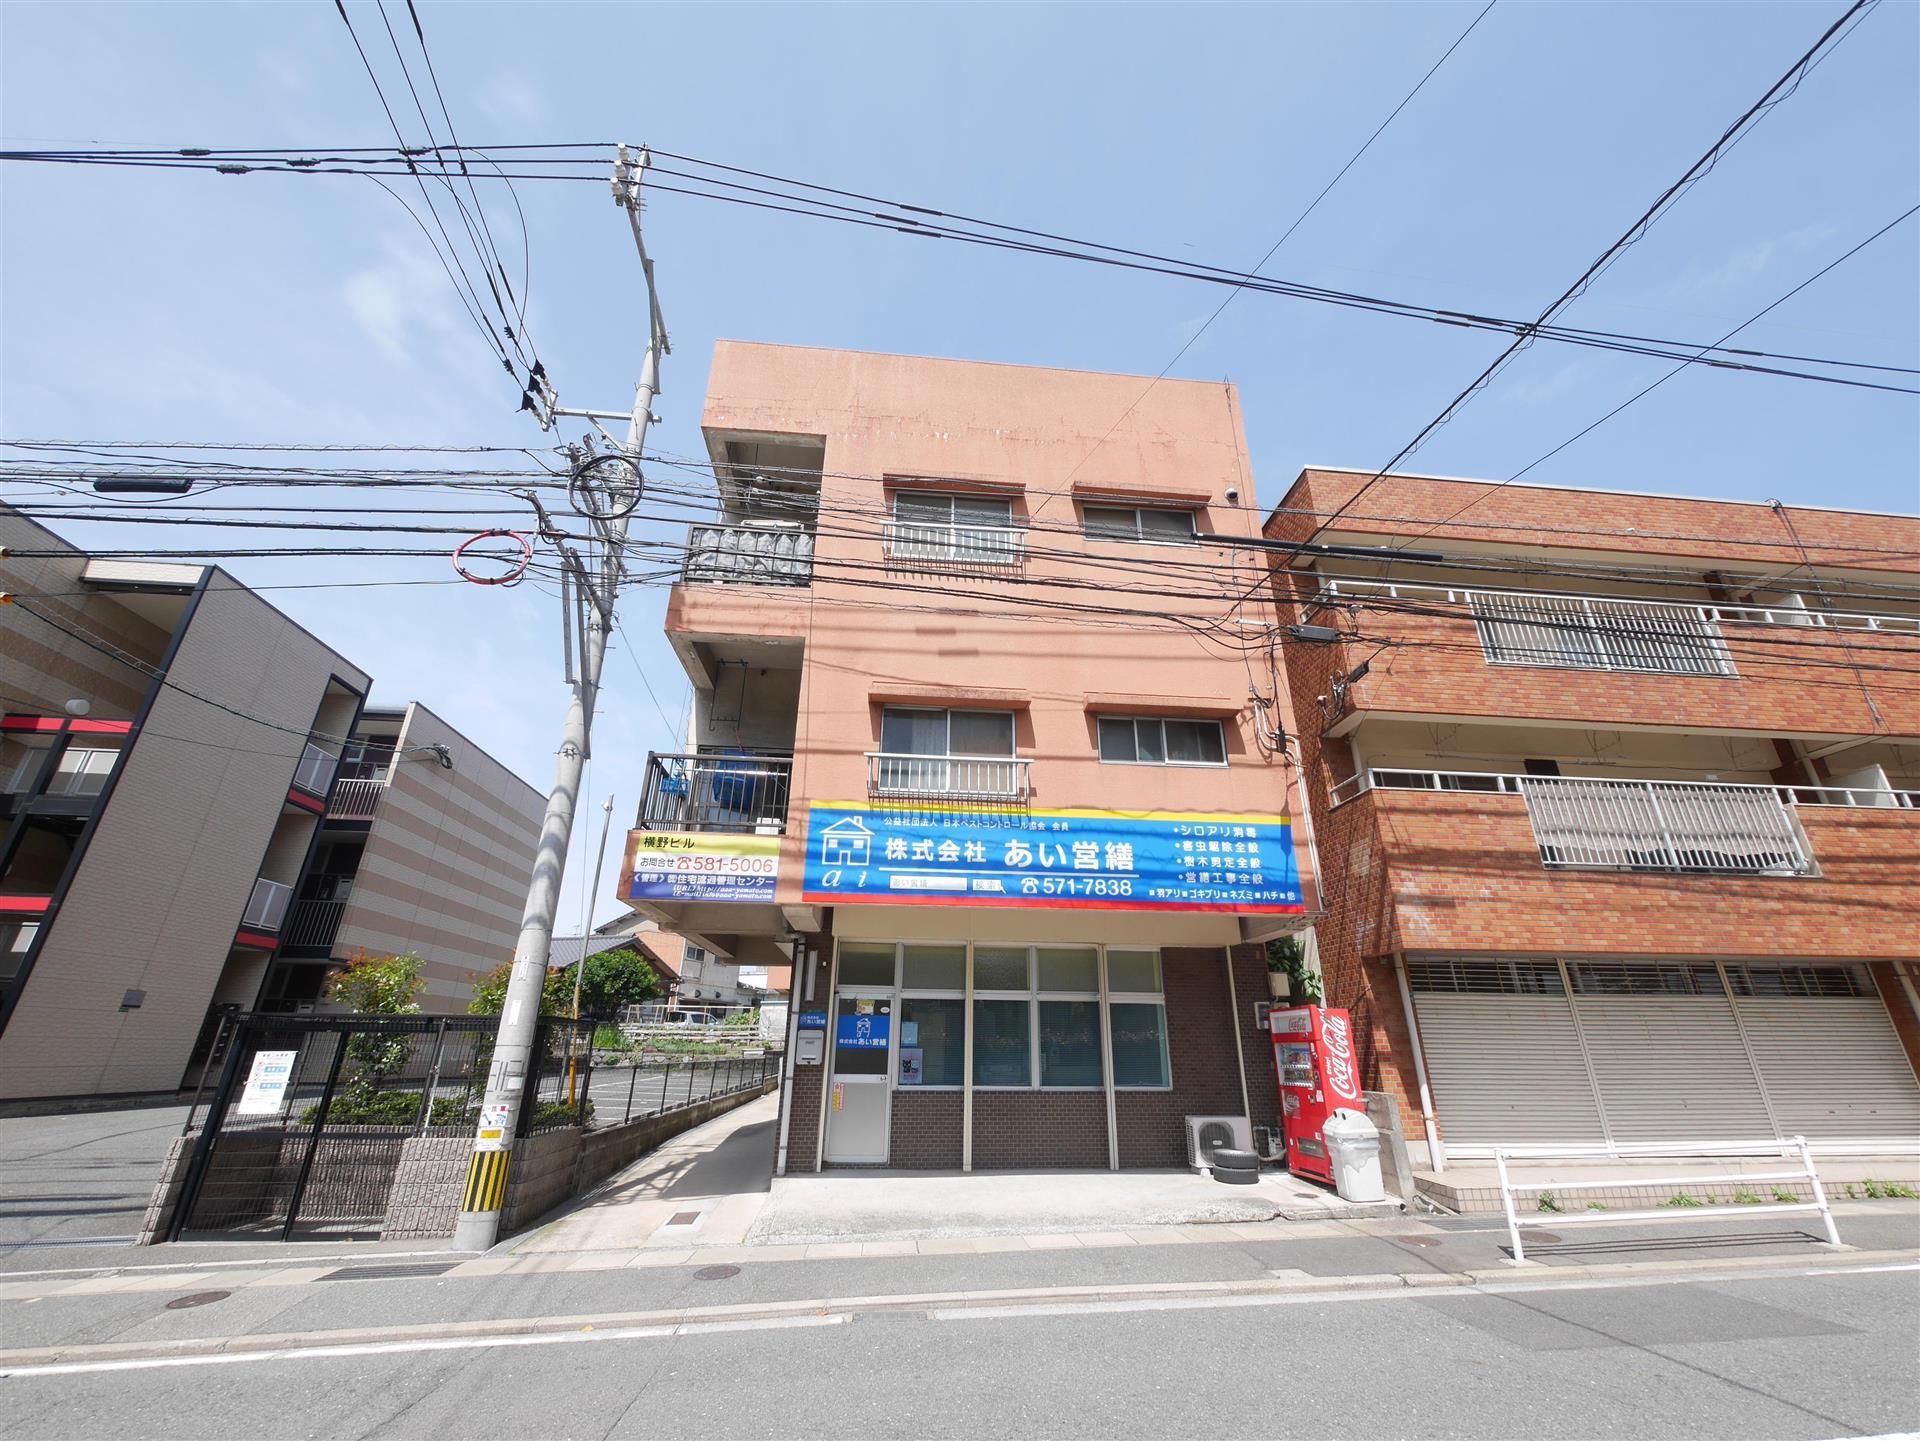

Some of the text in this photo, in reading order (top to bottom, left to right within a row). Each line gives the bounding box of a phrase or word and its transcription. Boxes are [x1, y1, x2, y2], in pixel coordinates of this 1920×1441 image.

[1052, 822, 1069, 831] 会員
[1181, 825, 1257, 838] シロアリ消毒
[644, 836, 695, 848] 横野ビル
[1182, 841, 1259, 853] 害虫駆除全般
[885, 838, 1134, 870] 株式会社 あい営繕
[640, 857, 773, 873] お問合せ 581-5006
[1184, 856, 1261, 869] 樹木剪定全般
[1185, 872, 1264, 885] 営繕工事全般
[1043, 878, 1132, 896] 571-7838
[1157, 888, 1296, 901] 羽アリ ゴキブリ ネズミ ハチ 他
